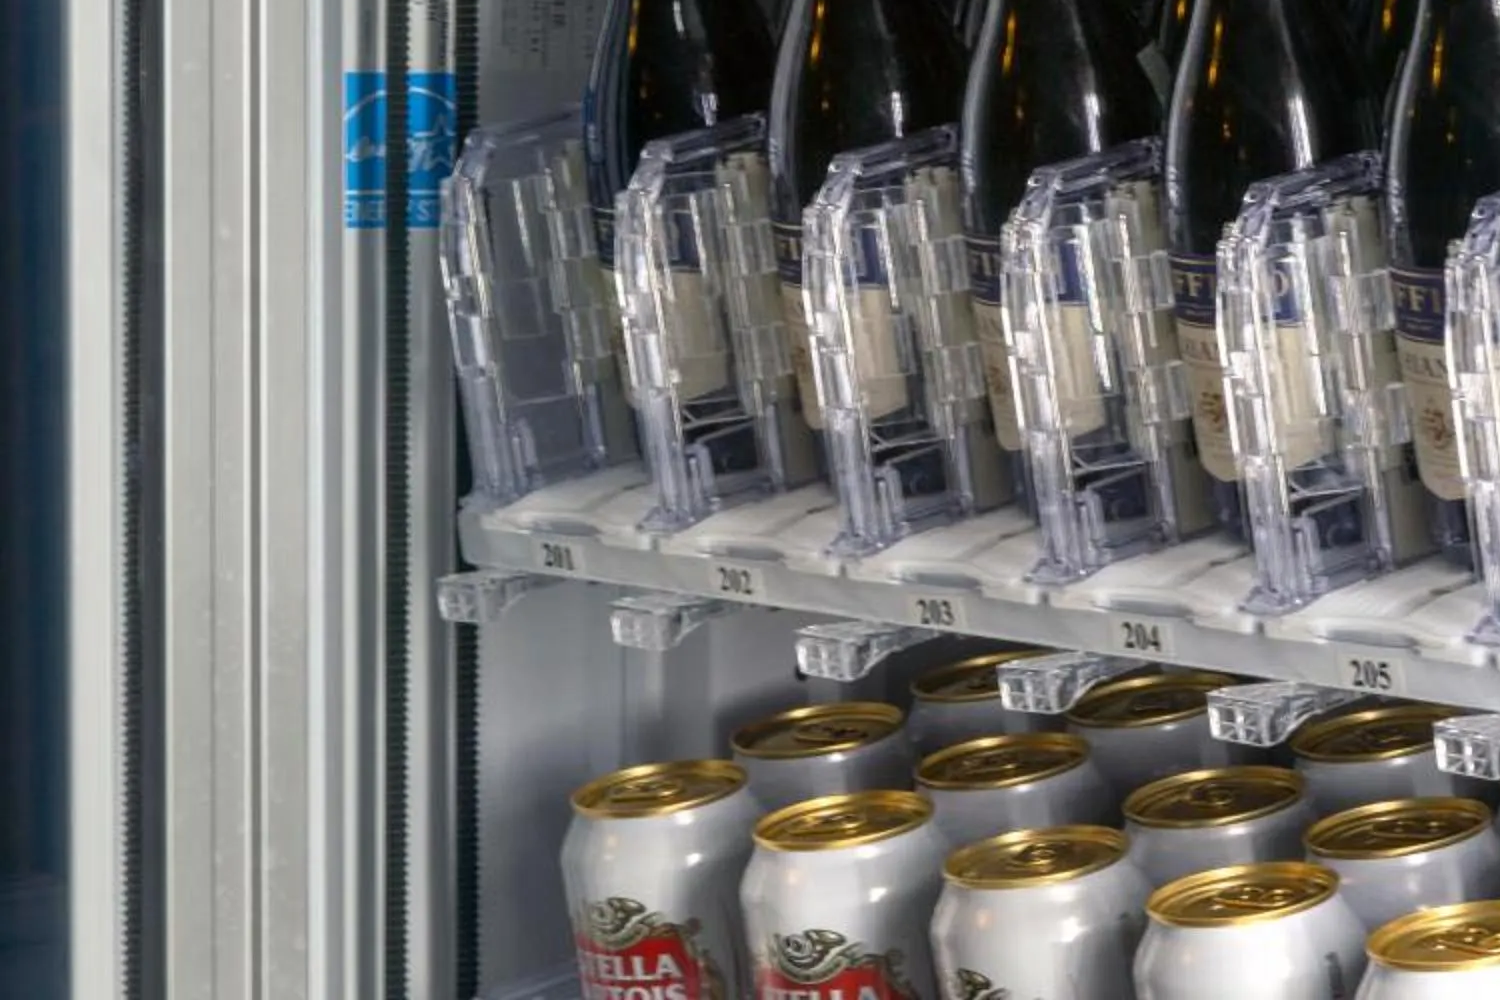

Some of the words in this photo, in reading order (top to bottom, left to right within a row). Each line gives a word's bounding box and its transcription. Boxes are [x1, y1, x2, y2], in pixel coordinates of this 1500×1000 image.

[542, 542, 575, 571] 201
[719, 565, 752, 595] 202
[917, 598, 955, 627] 203
[1121, 621, 1161, 652] 204
[1351, 659, 1392, 690] 205
